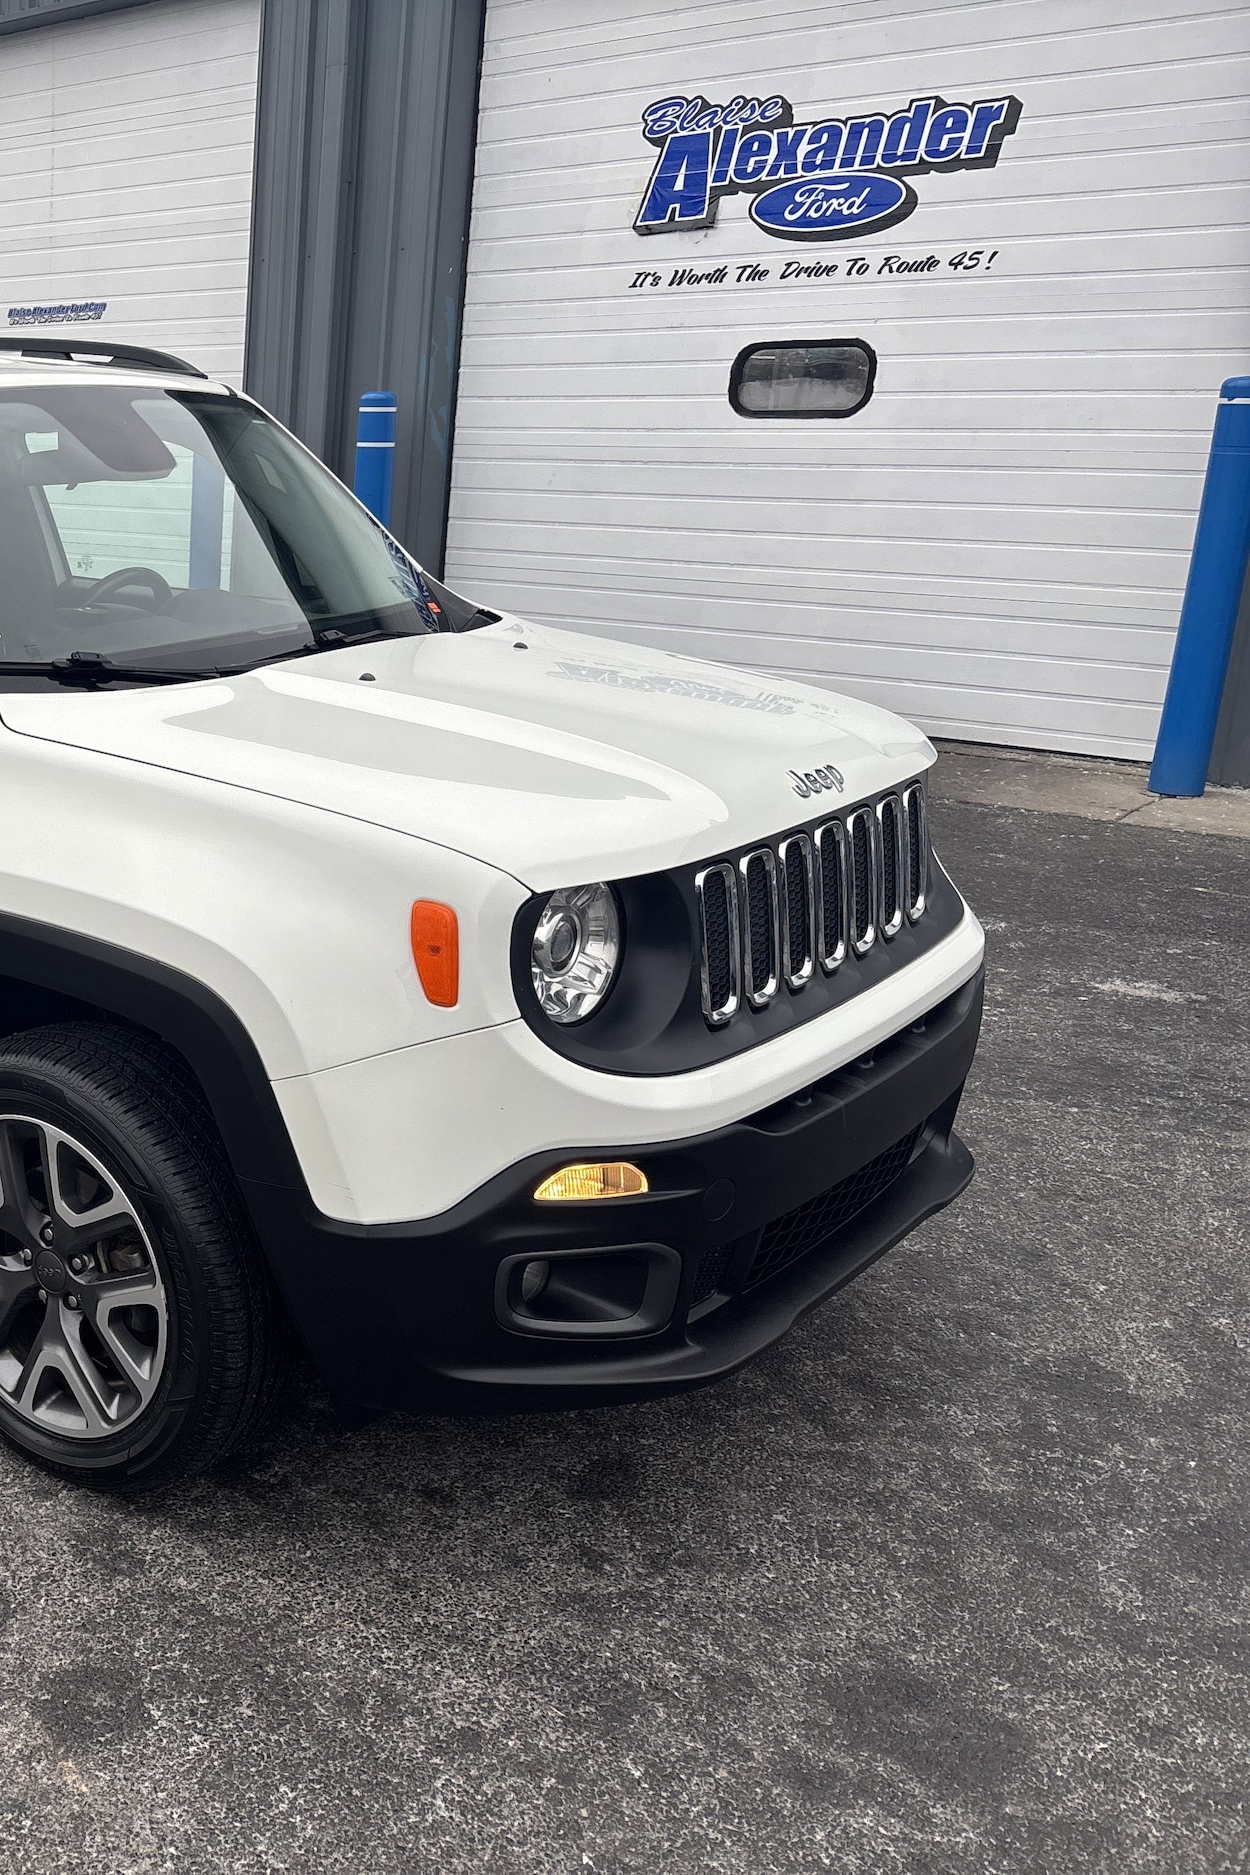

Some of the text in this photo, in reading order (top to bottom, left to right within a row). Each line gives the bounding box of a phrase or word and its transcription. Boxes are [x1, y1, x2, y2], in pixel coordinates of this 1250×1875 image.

[643, 96, 786, 138] Blaise
[635, 97, 1016, 229] Alexander
[783, 182, 869, 222] Ford
[628, 271, 662, 288] It's
[668, 265, 729, 287] Worth
[735, 263, 770, 283] The
[779, 261, 839, 280] Drive
[846, 257, 870, 276] To
[877, 255, 941, 275] Route
[785, 764, 844, 798] Jeep
